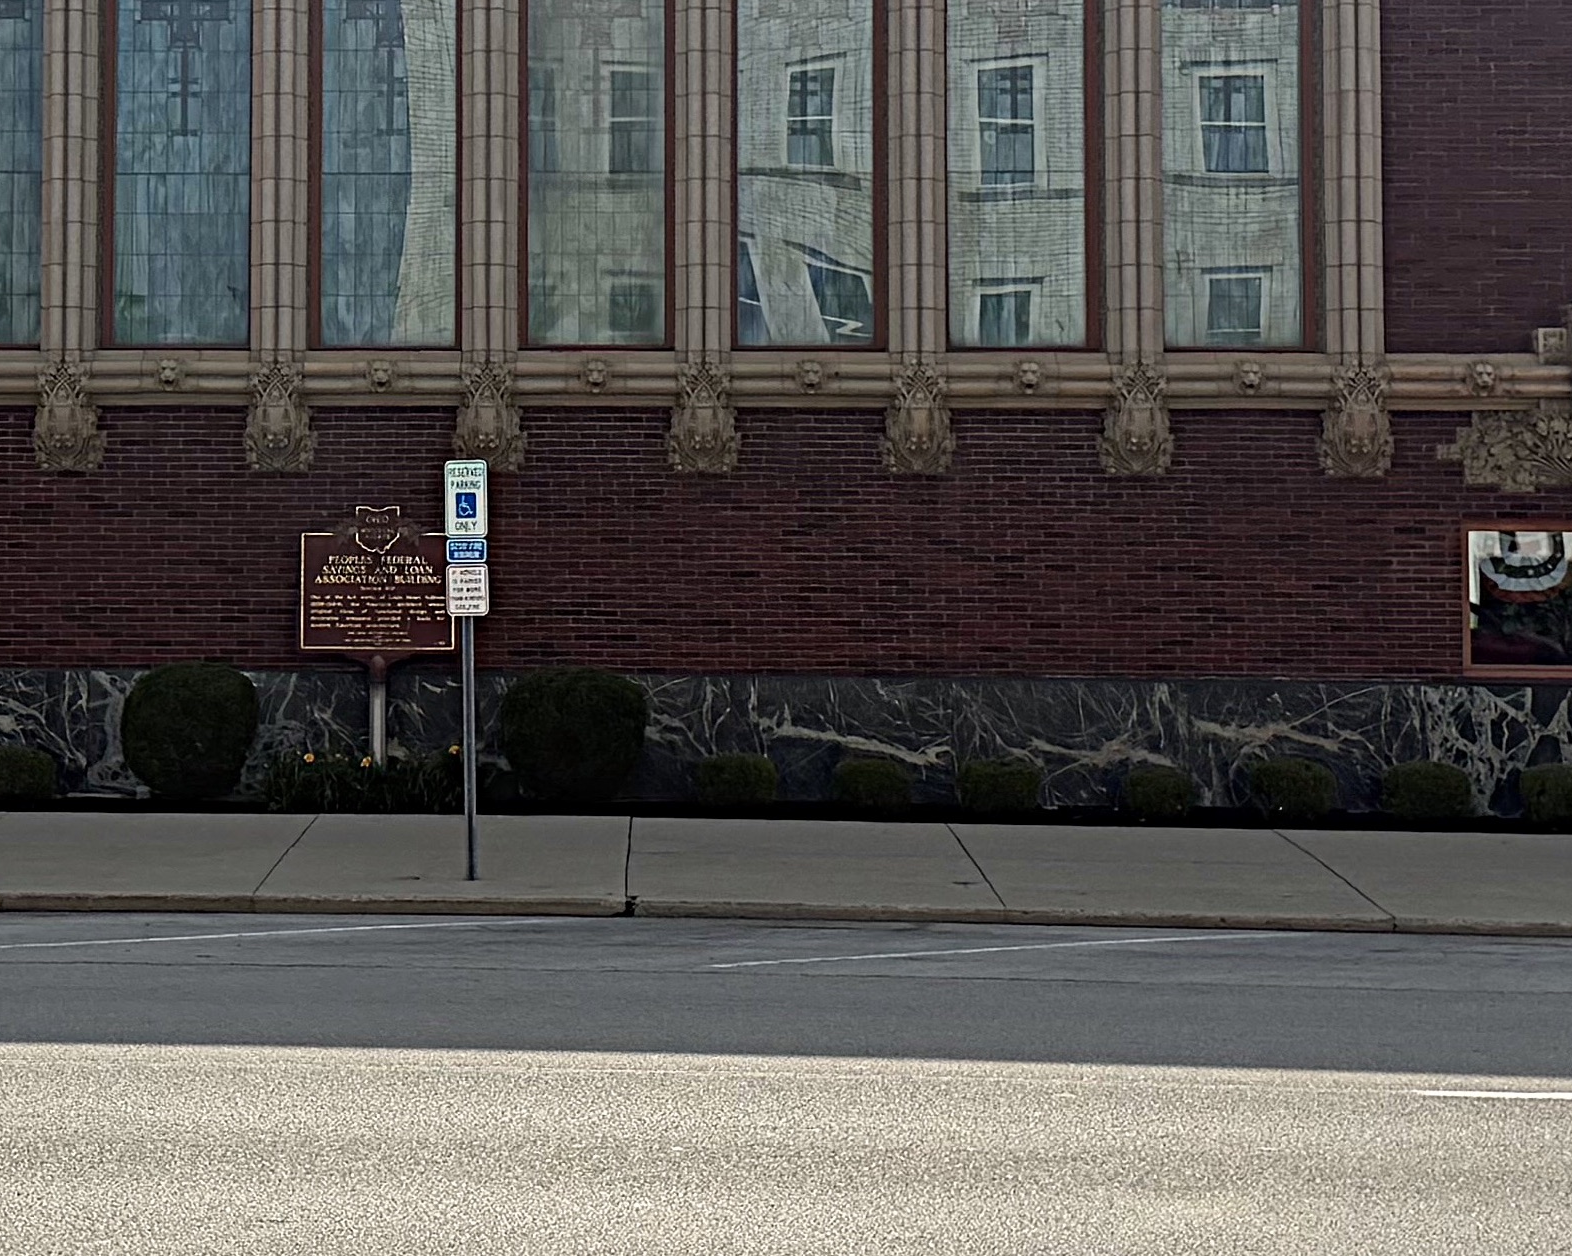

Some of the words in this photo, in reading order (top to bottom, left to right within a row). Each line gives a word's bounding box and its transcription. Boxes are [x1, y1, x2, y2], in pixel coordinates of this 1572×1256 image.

[454, 520, 478, 532] ONLY
[321, 565, 367, 575] SAVINGS
[404, 565, 434, 575] LOAN
[314, 575, 388, 585] ASSOCIATION
